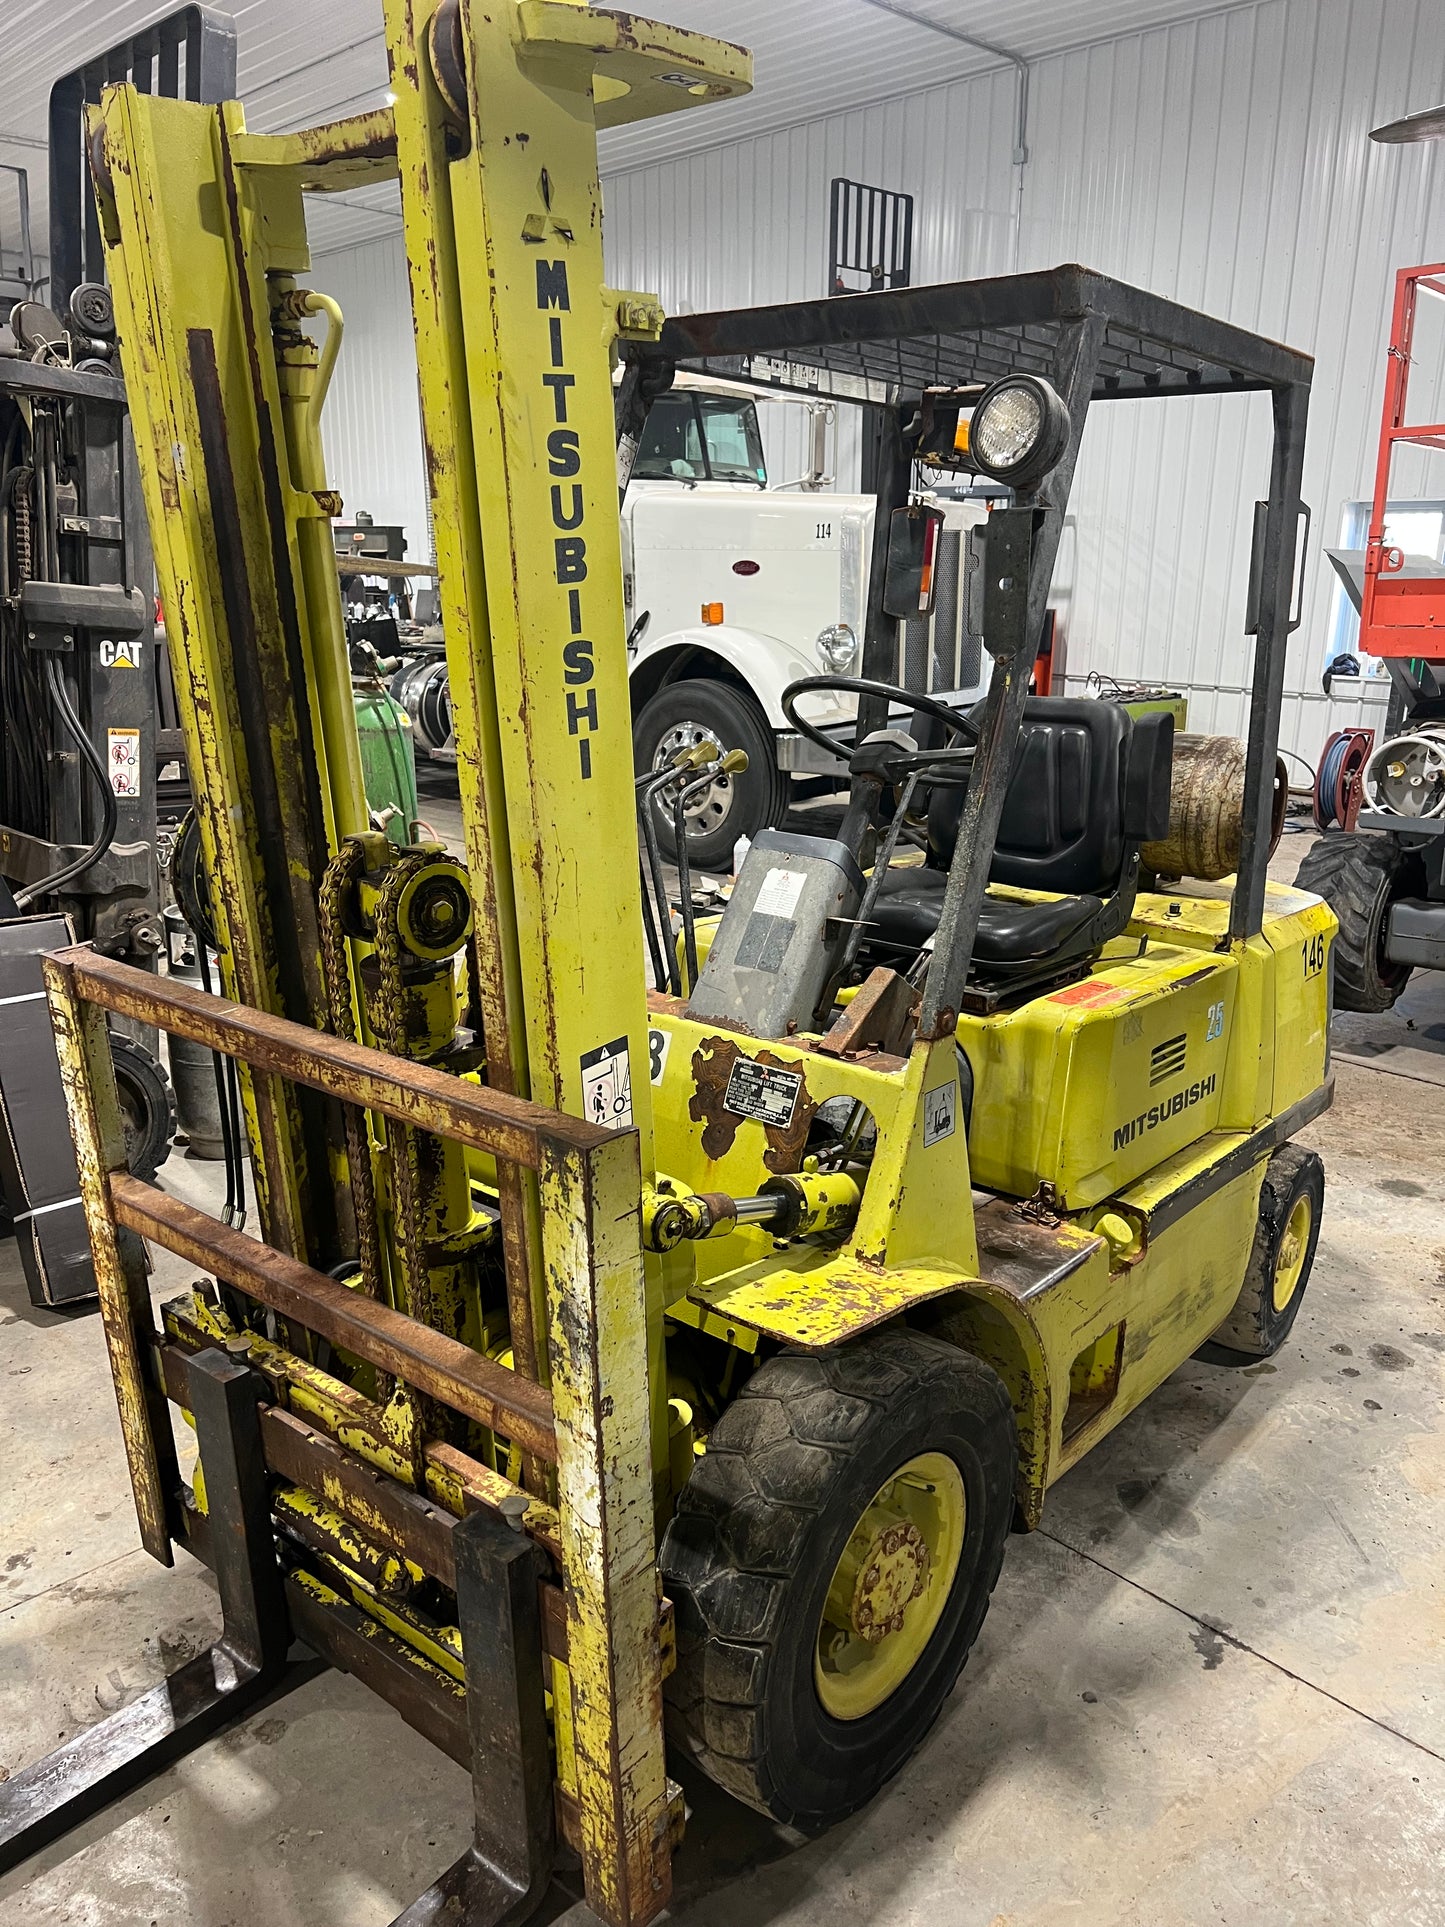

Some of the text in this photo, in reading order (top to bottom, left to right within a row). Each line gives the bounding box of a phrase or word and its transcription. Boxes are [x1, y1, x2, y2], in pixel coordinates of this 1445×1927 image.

[535, 259, 599, 780] MITSUBISHI
[815, 523, 831, 539] 114
[99, 639, 143, 669] CAT
[1301, 933, 1324, 977] 146
[1205, 999, 1225, 1042] 25
[648, 1030, 665, 1081] 8
[1112, 1072, 1217, 1152] MITSUBISHI
